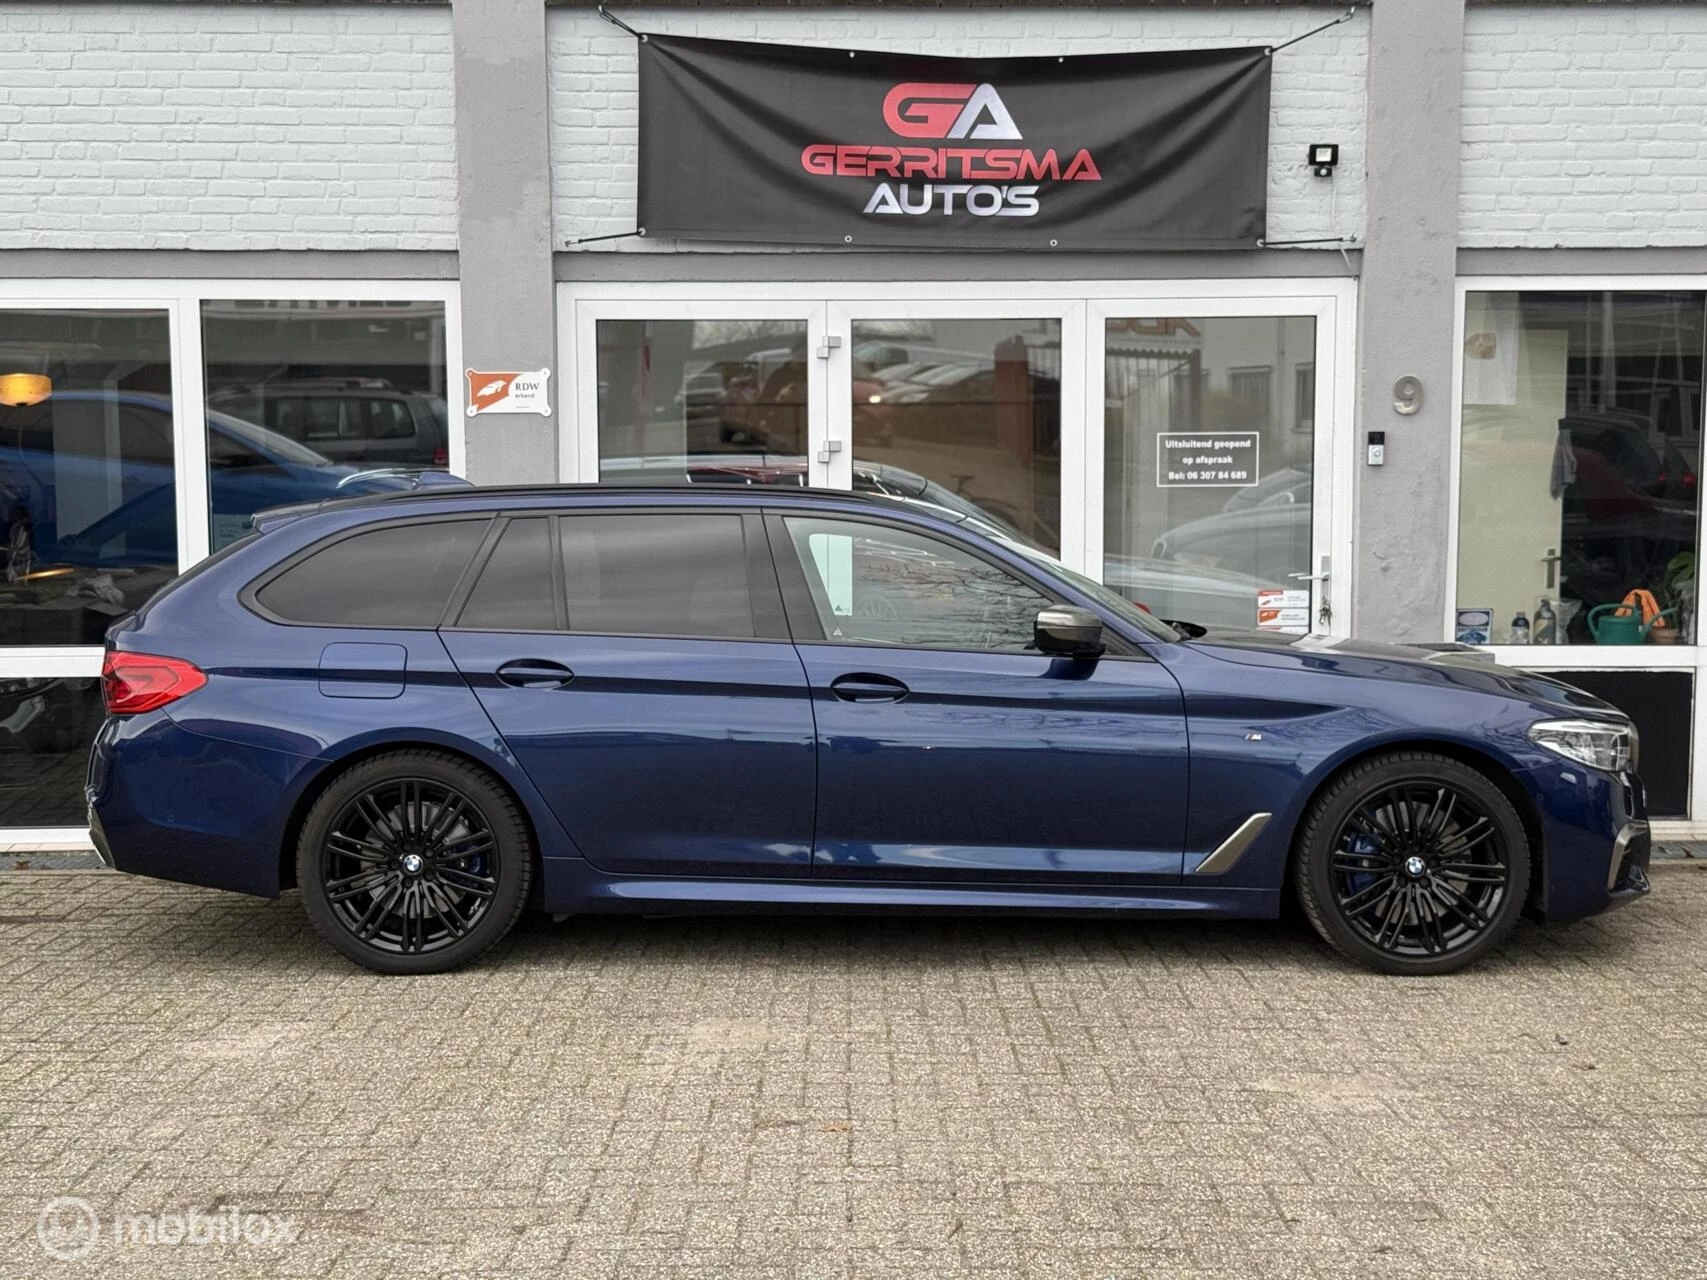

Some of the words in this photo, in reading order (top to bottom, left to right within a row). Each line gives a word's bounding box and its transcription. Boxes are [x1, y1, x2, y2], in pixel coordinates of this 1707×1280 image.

[882, 82, 1024, 140] GA
[801, 143, 1103, 180] GERRITSMA
[863, 182, 1040, 217] AUTO'S
[515, 382, 540, 391] RDW
[1392, 374, 1424, 416] 9
[1165, 439, 1212, 449] Uitsluitend
[1213, 439, 1251, 450] geopend
[1182, 456, 1194, 466] op
[1195, 455, 1233, 466] afspraak
[1168, 471, 1185, 480] Bel:
[1187, 471, 1198, 480] 06
[1200, 471, 1216, 480] 307
[1218, 471, 1229, 480] 84
[1230, 471, 1247, 480] 689
